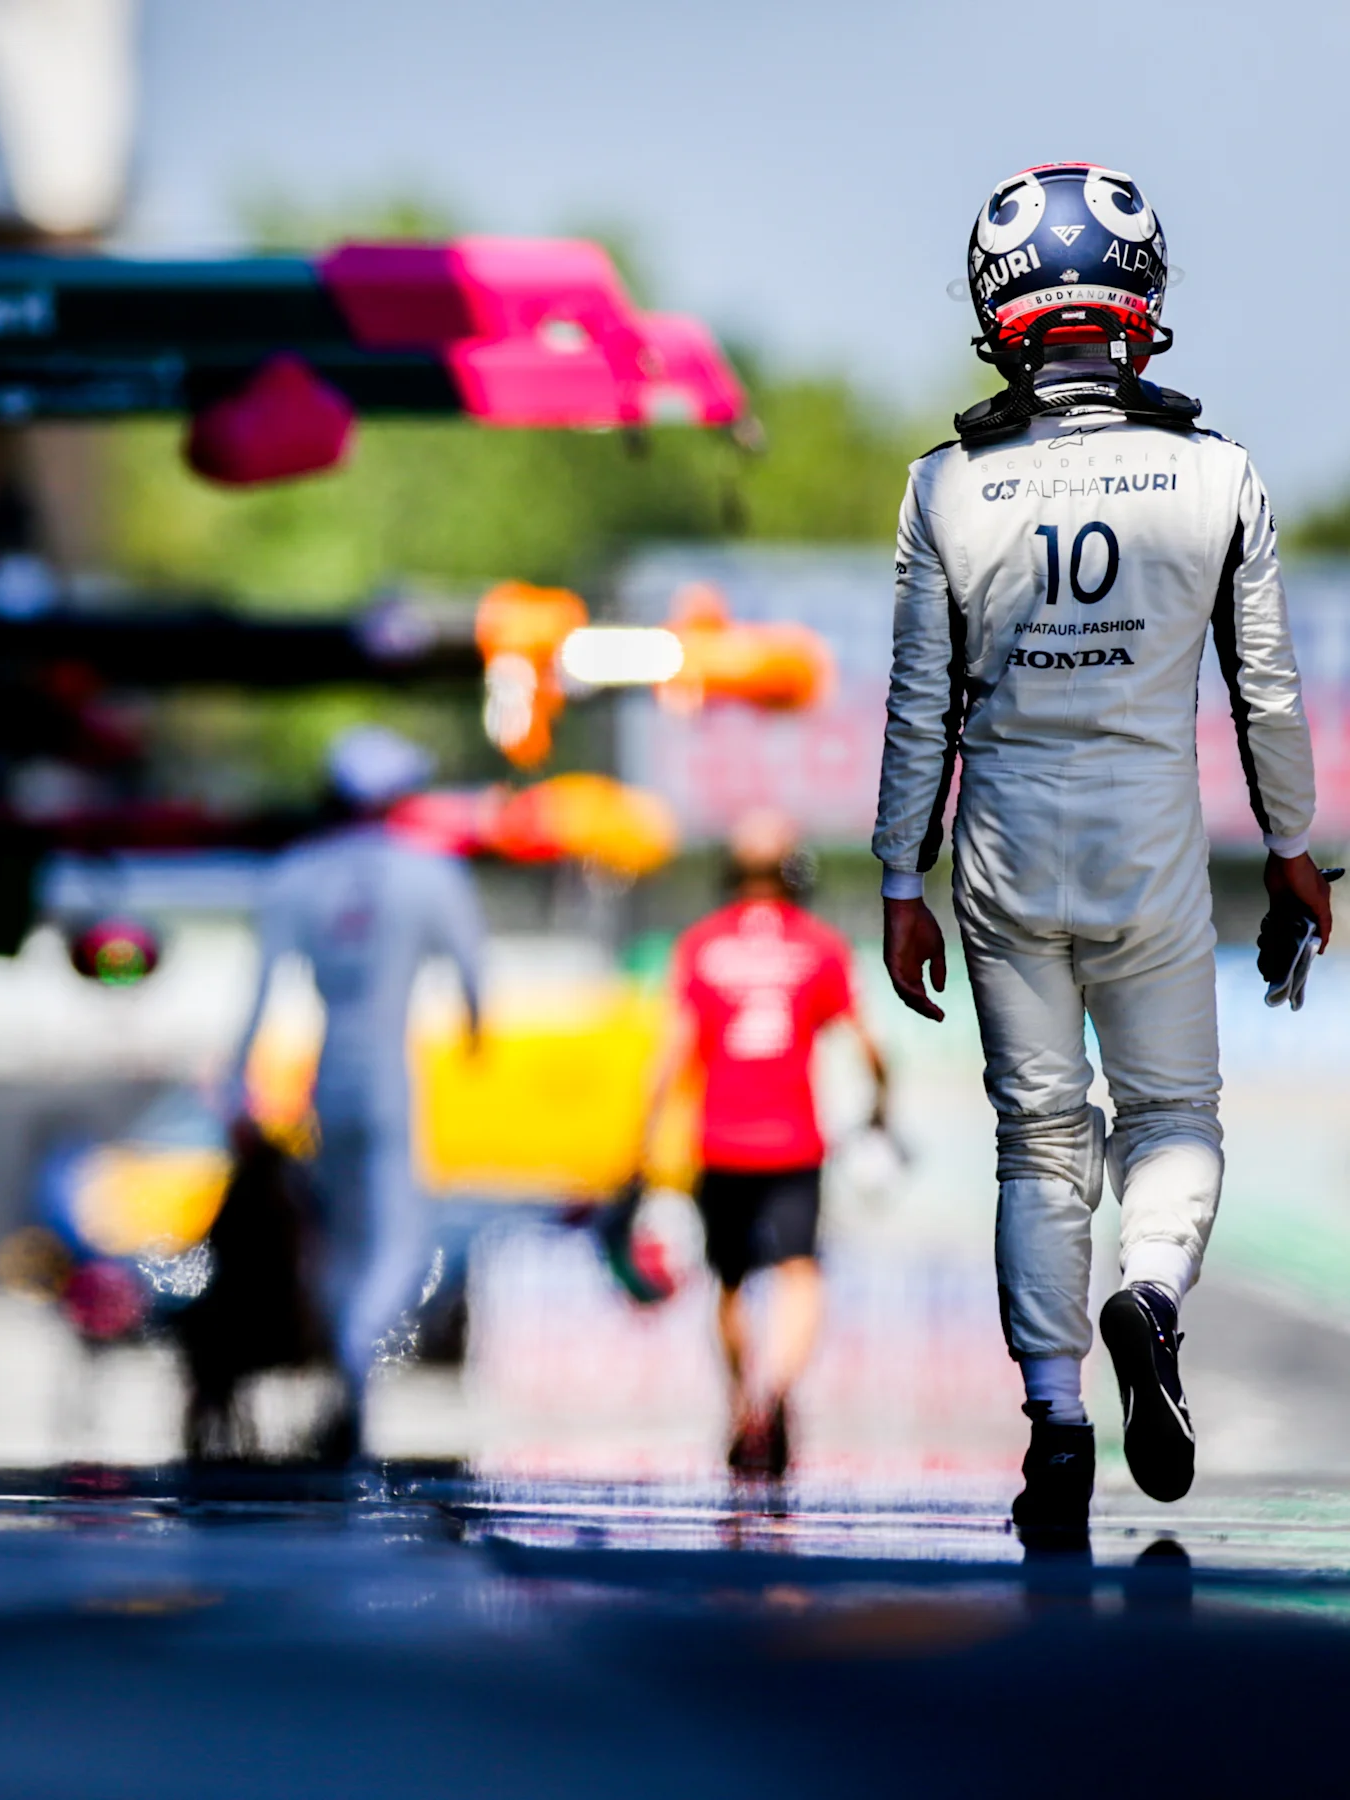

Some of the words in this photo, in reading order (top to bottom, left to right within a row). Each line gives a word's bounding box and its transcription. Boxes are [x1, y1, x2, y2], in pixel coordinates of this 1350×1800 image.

[976, 243, 1041, 300] TAURI
[980, 453, 1178, 473] SCUDERIA
[1025, 473, 1177, 499] ALPHATAURI
[1035, 521, 1120, 605] 10
[1005, 647, 1135, 669] HONDA
